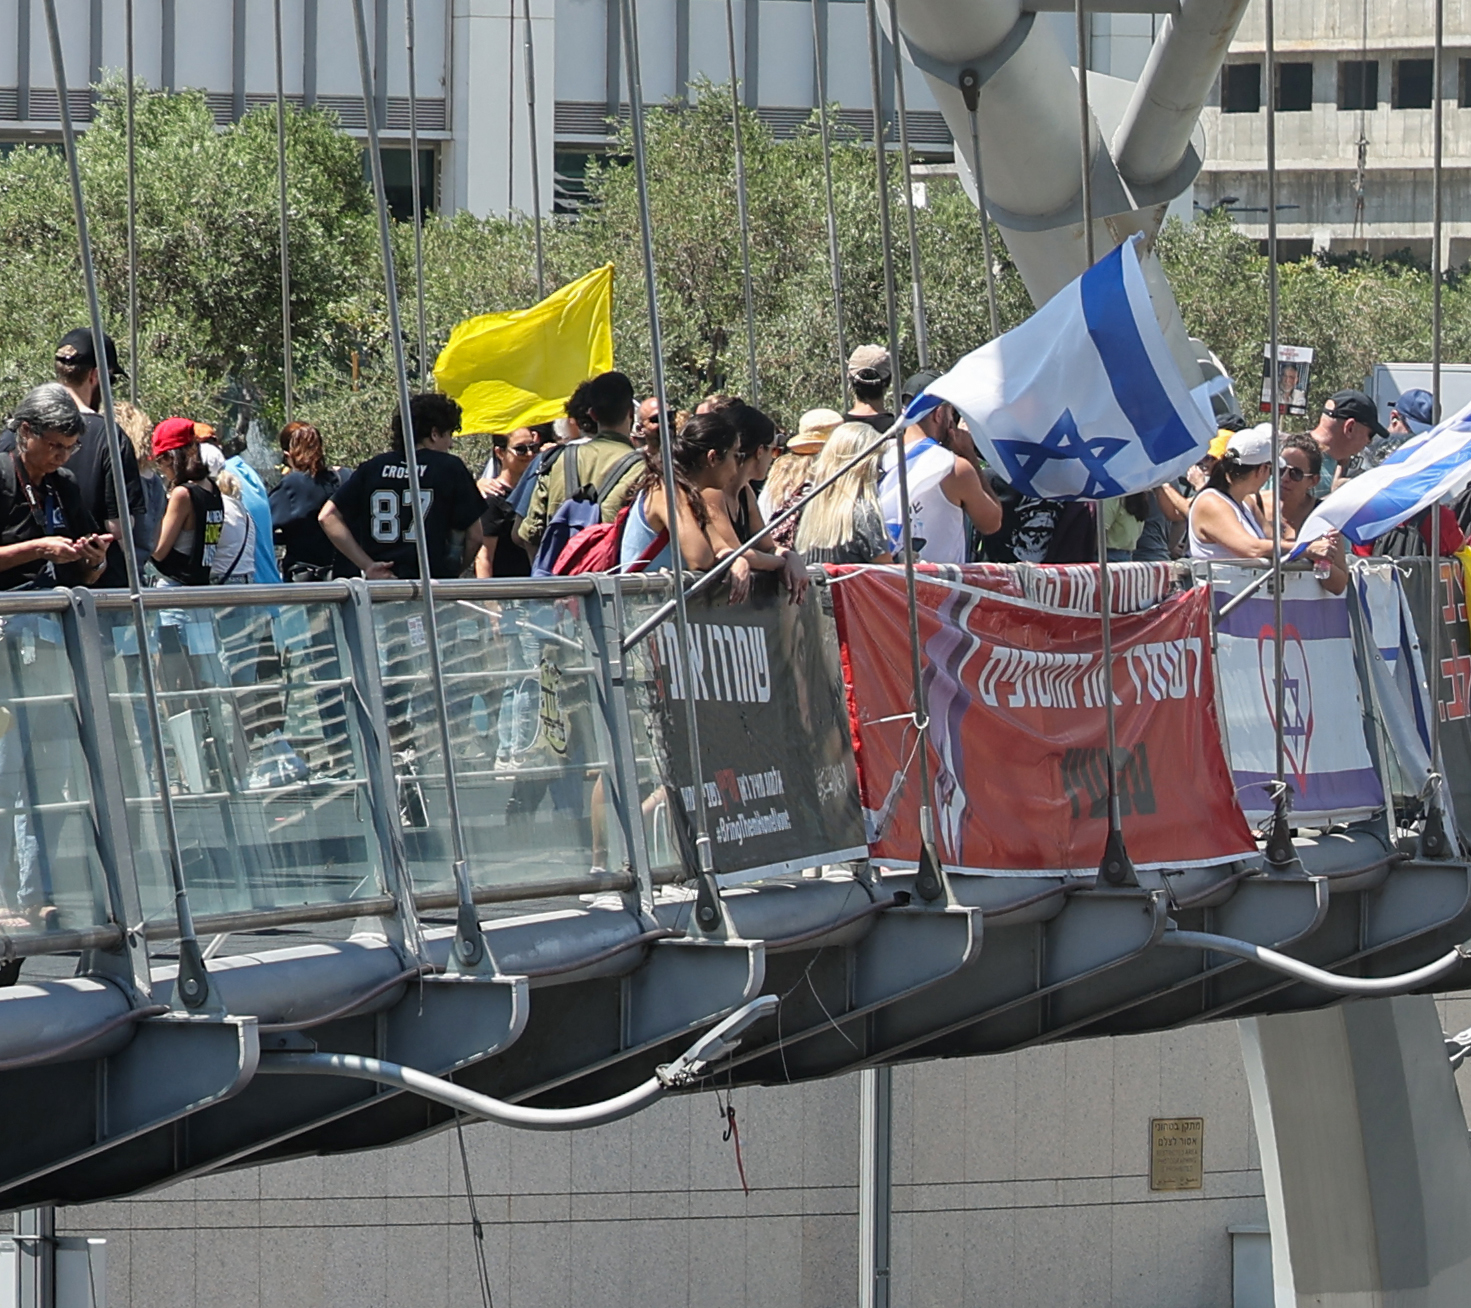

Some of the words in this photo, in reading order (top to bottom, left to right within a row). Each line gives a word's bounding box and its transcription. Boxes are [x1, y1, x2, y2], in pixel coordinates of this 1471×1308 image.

[370, 493, 434, 549] 87
[706, 624, 771, 703] שחררו
[978, 645, 1080, 709] החטופים
